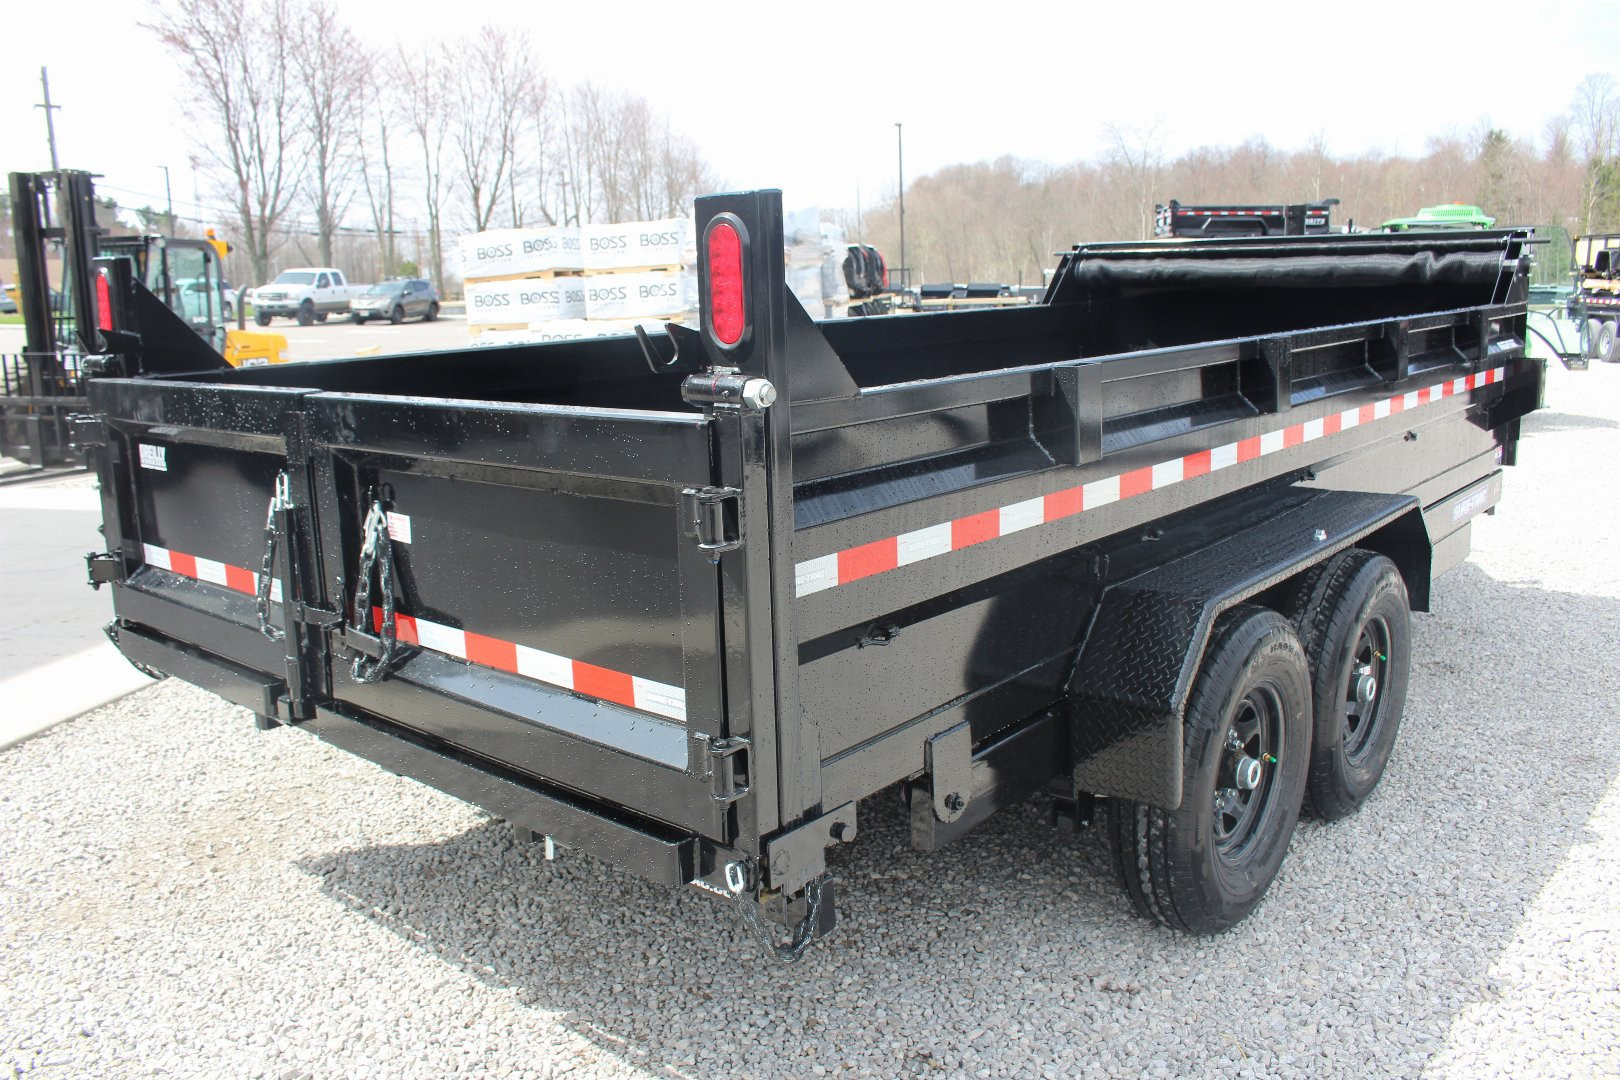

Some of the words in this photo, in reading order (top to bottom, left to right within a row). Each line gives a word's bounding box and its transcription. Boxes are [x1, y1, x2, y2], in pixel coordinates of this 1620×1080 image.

[562, 237, 581, 250] BOSS
[589, 235, 627, 251] BOSS
[639, 231, 679, 247] BOSS
[477, 243, 513, 260] BOSS
[474, 293, 511, 307] BOSS
[520, 291, 561, 305] BOSS
[564, 289, 584, 304] BOSS
[588, 286, 627, 301] BOSS
[639, 283, 678, 298] BOSS
